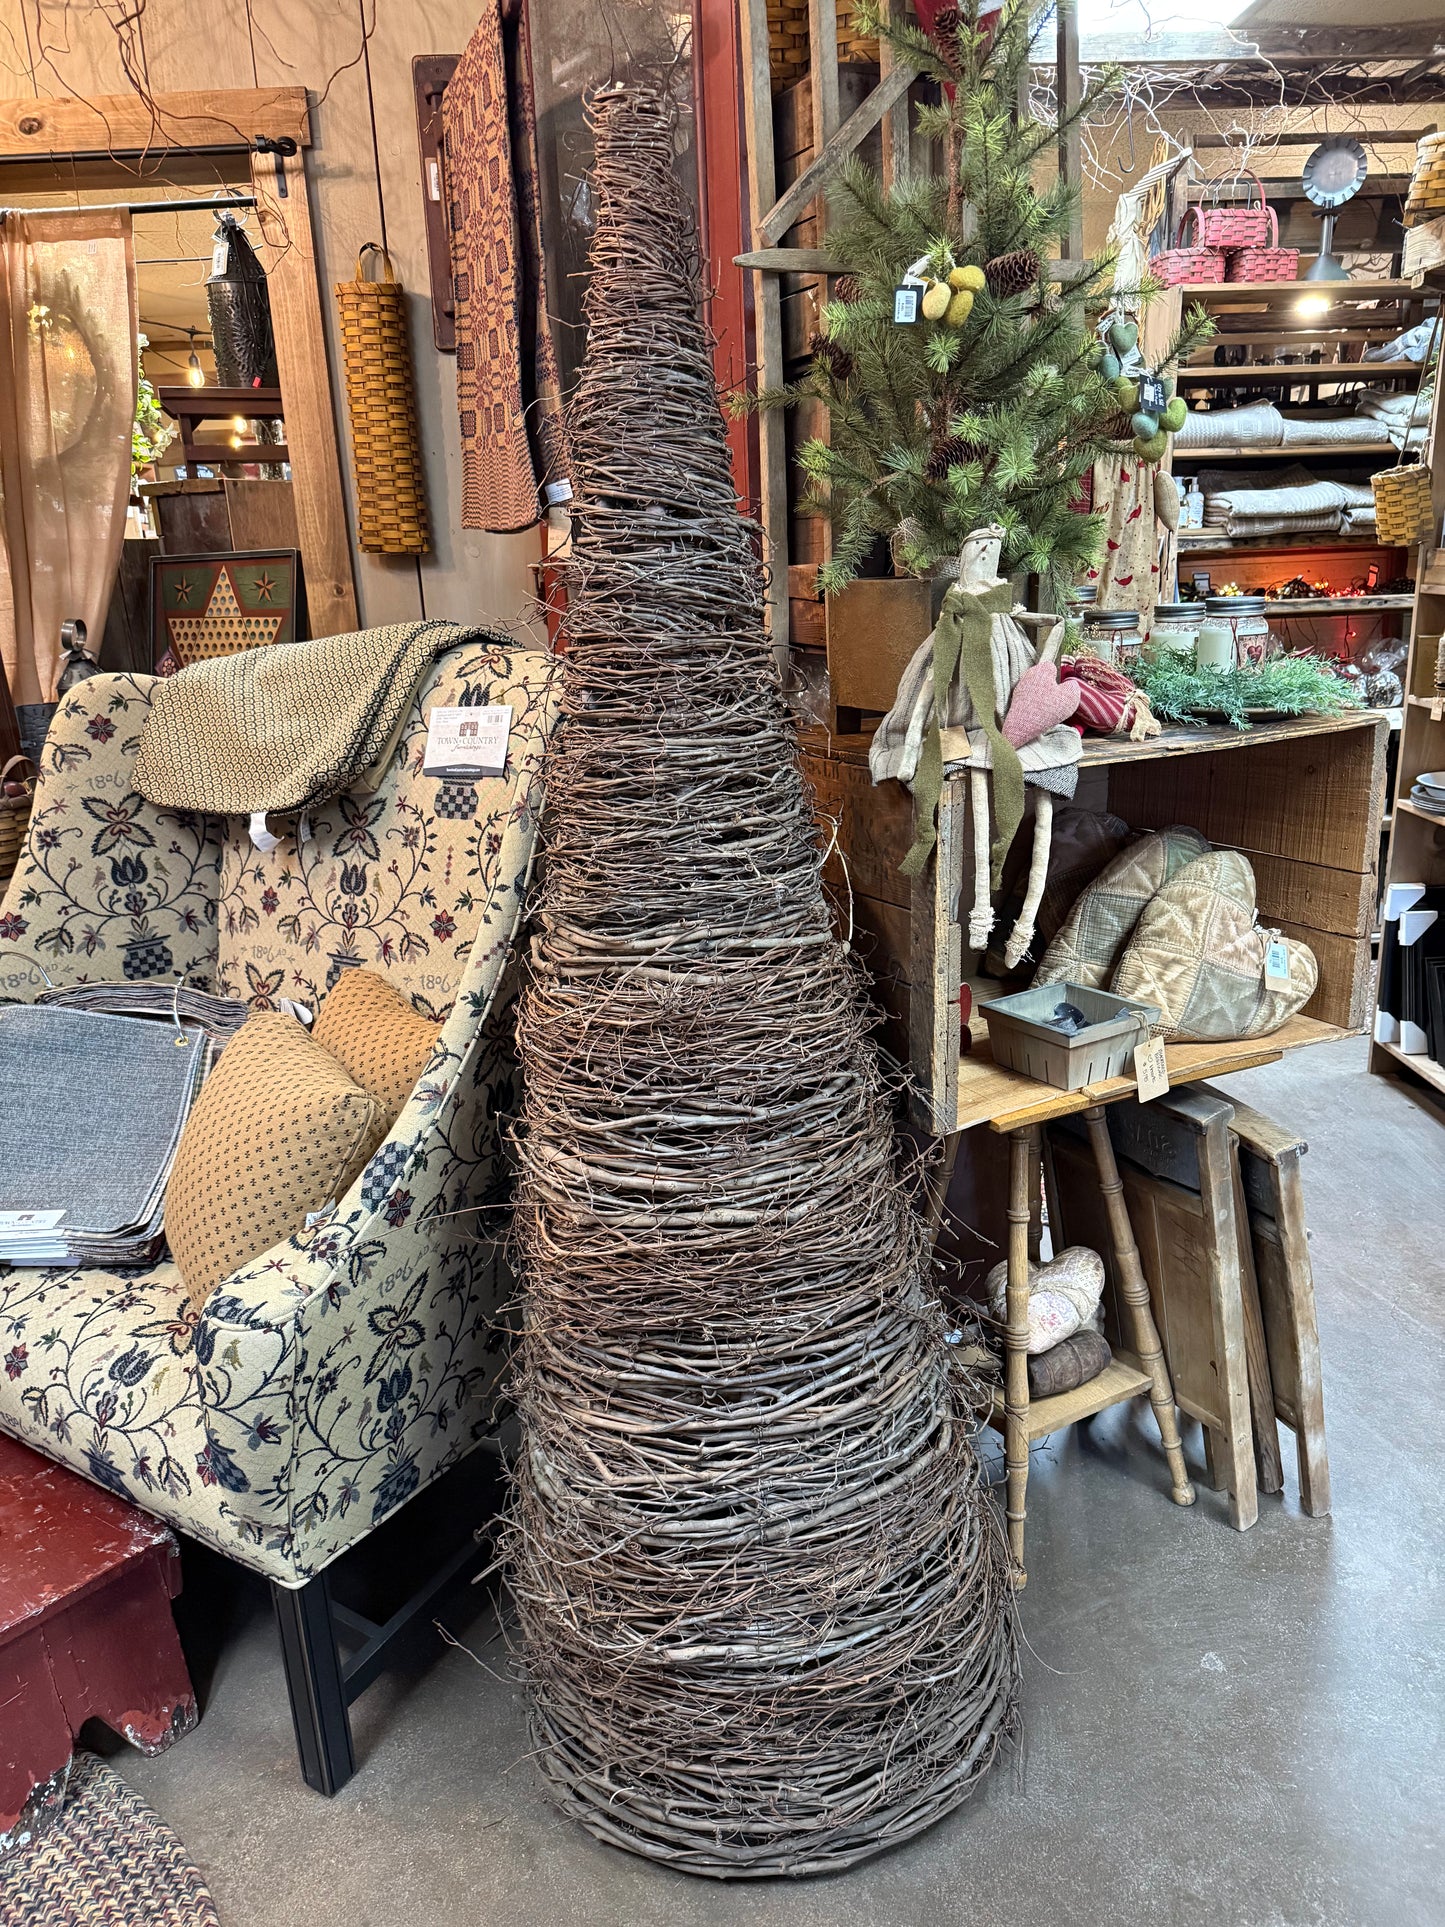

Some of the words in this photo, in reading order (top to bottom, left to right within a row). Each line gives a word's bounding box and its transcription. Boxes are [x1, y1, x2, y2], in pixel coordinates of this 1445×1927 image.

[437, 736, 459, 745] TOWN
[462, 736, 499, 745] COUNTRY
[85, 769, 125, 791] 1806
[251, 944, 275, 963] 1806
[419, 973, 451, 993] 1806
[376, 1257, 414, 1298] 1806
